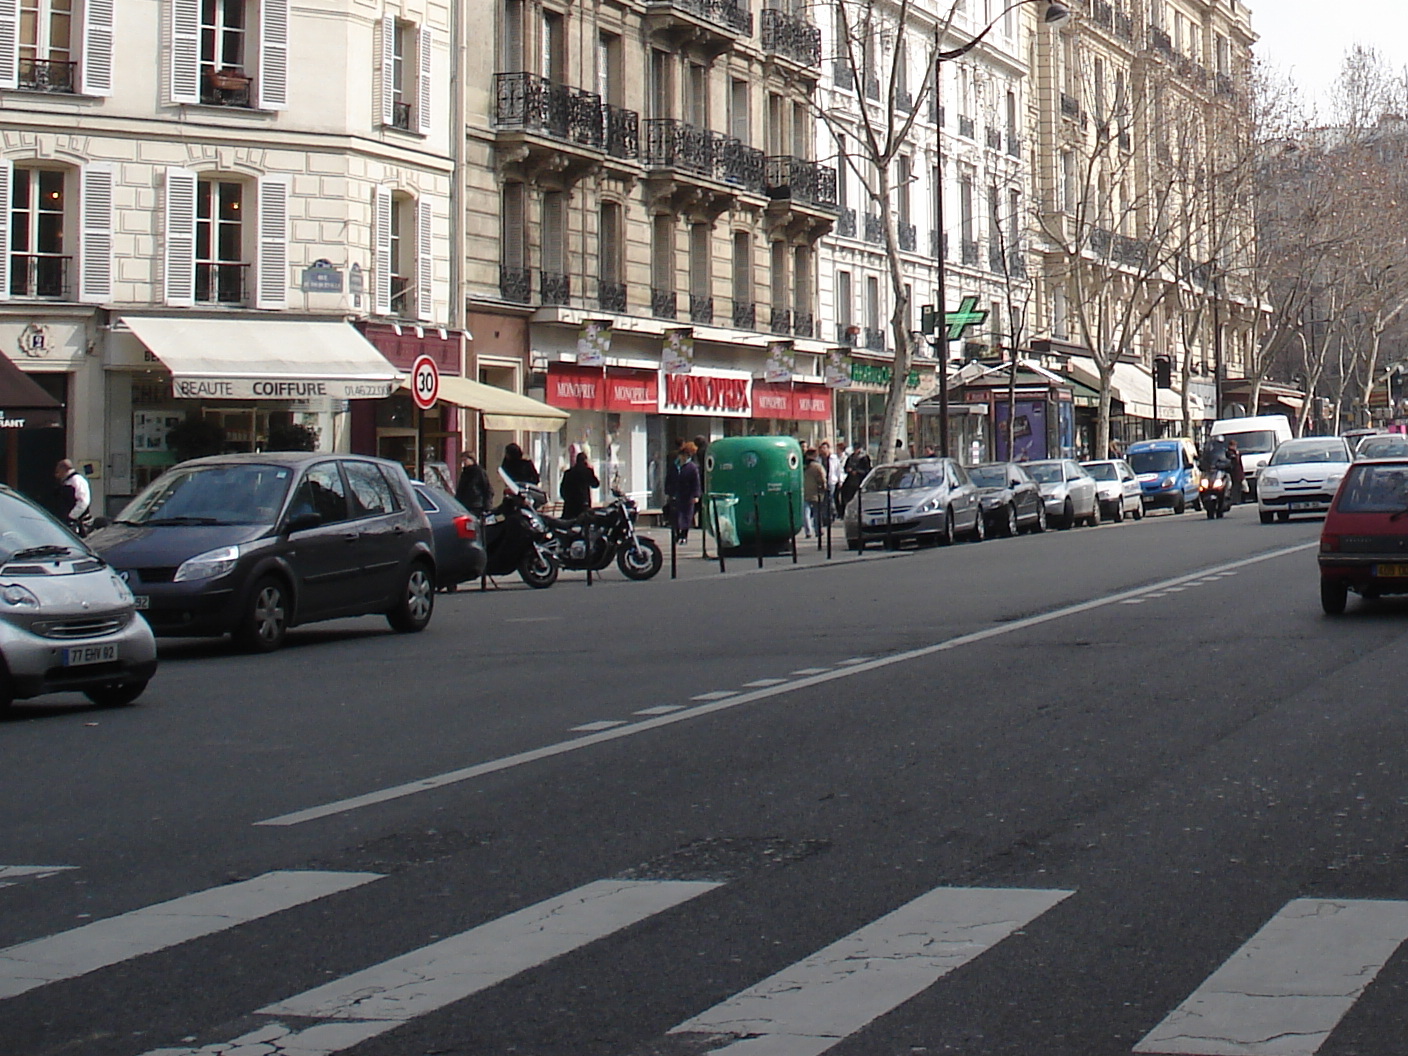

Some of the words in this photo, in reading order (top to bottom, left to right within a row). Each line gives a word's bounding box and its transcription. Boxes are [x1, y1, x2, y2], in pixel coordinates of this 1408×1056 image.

[181, 381, 234, 396] BEAUTE
[253, 381, 327, 396] COIFFURE
[418, 372, 433, 393] 30
[557, 382, 596, 399] MONOPRIX
[614, 386, 649, 401] MONOPRIX
[667, 373, 751, 410] MONOPRIX
[71, 649, 83, 663] 77
